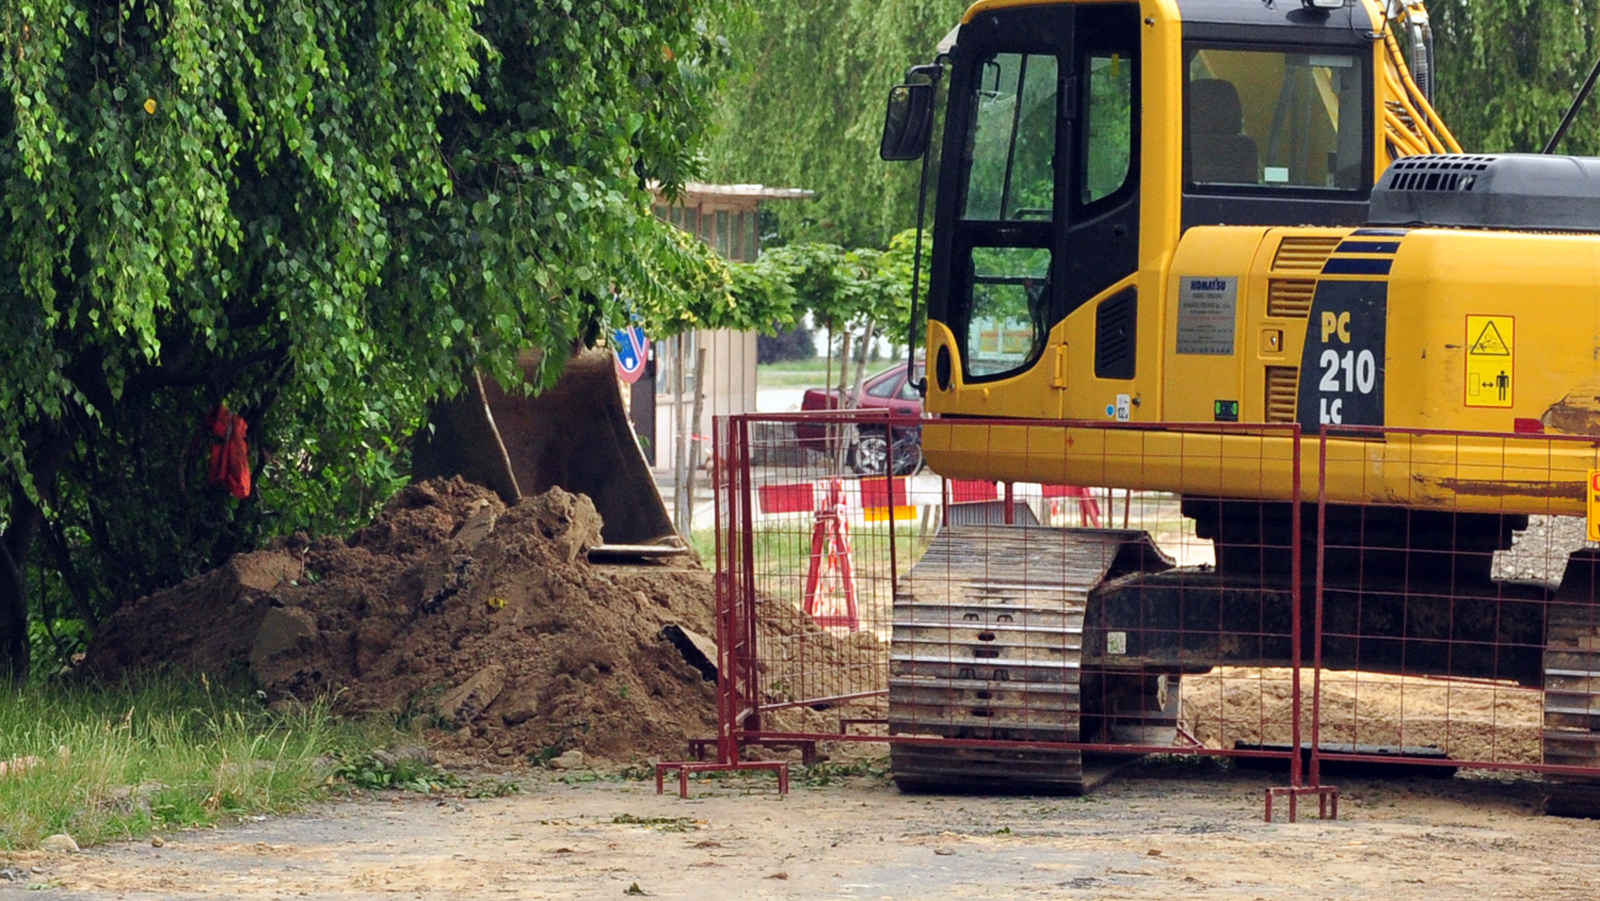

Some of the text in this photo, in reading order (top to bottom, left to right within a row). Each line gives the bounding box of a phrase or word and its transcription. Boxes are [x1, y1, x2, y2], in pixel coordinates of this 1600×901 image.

[1190, 278, 1226, 291] KOMATSU
[1321, 311, 1350, 344] PC
[1319, 349, 1375, 394] 210
[1320, 398, 1342, 424] LC
